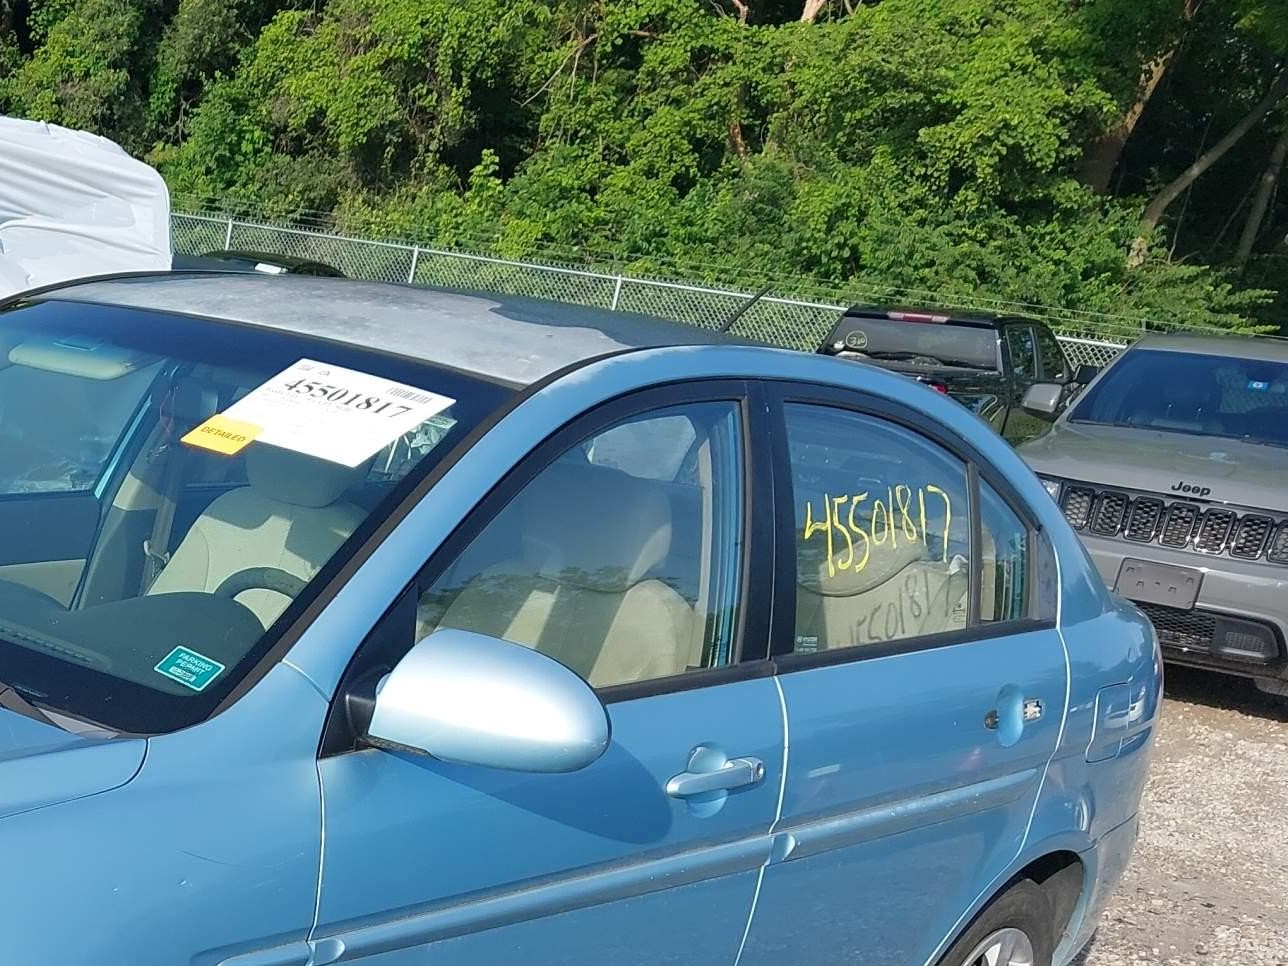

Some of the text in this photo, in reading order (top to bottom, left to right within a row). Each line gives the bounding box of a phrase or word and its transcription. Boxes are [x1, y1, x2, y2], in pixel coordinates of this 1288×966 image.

[284, 377, 414, 418] 45501817
[201, 425, 247, 443] DETAILED
[1171, 481, 1211, 497] Jeep
[804, 484, 952, 578] 45501817
[175, 659, 206, 675] PERMIT
[178, 652, 213, 671] PARKING
